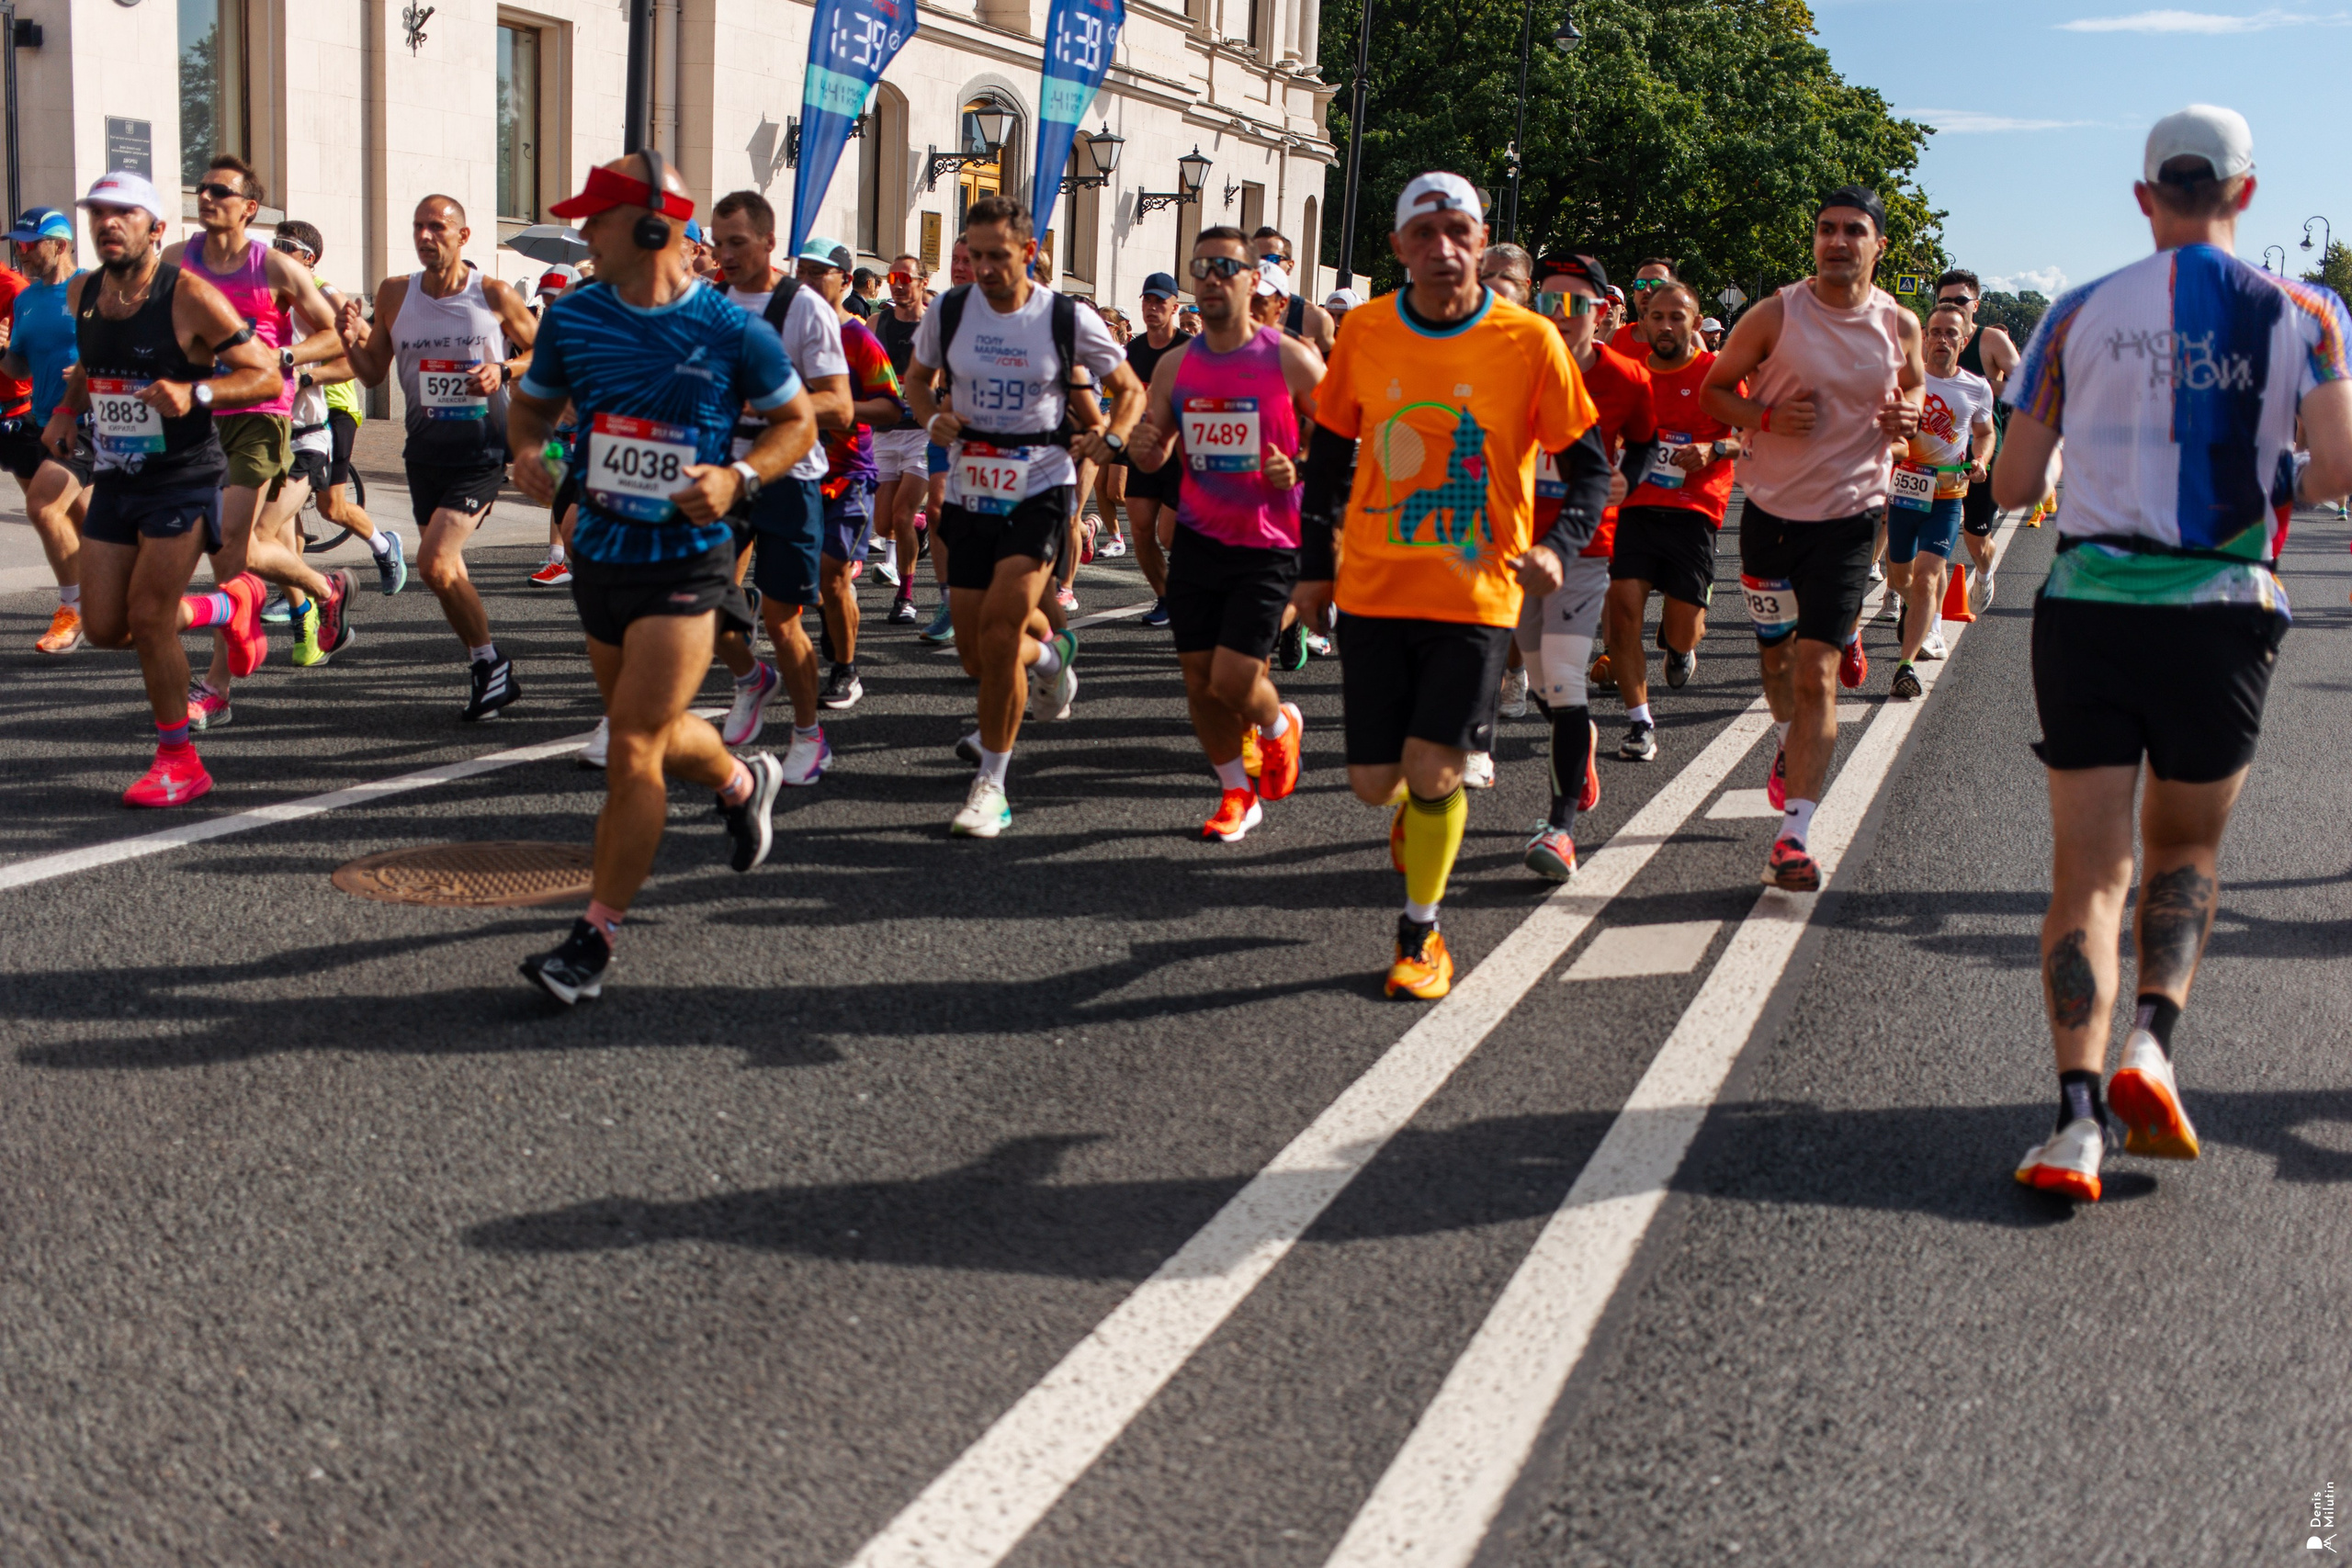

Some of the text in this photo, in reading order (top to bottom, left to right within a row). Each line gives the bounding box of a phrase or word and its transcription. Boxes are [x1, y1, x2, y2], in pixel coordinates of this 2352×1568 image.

[831, 7, 887, 73] 1:39
[434, 337, 451, 347] WE
[972, 378, 1024, 411] 1:39
[98, 400, 149, 423] 2883
[107, 424, 136, 433] КИРИЛЛ
[1192, 423, 1248, 446] 7489
[603, 444, 680, 482] 4038
[966, 466, 1018, 491] 7612
[1894, 472, 1928, 493] 5530
